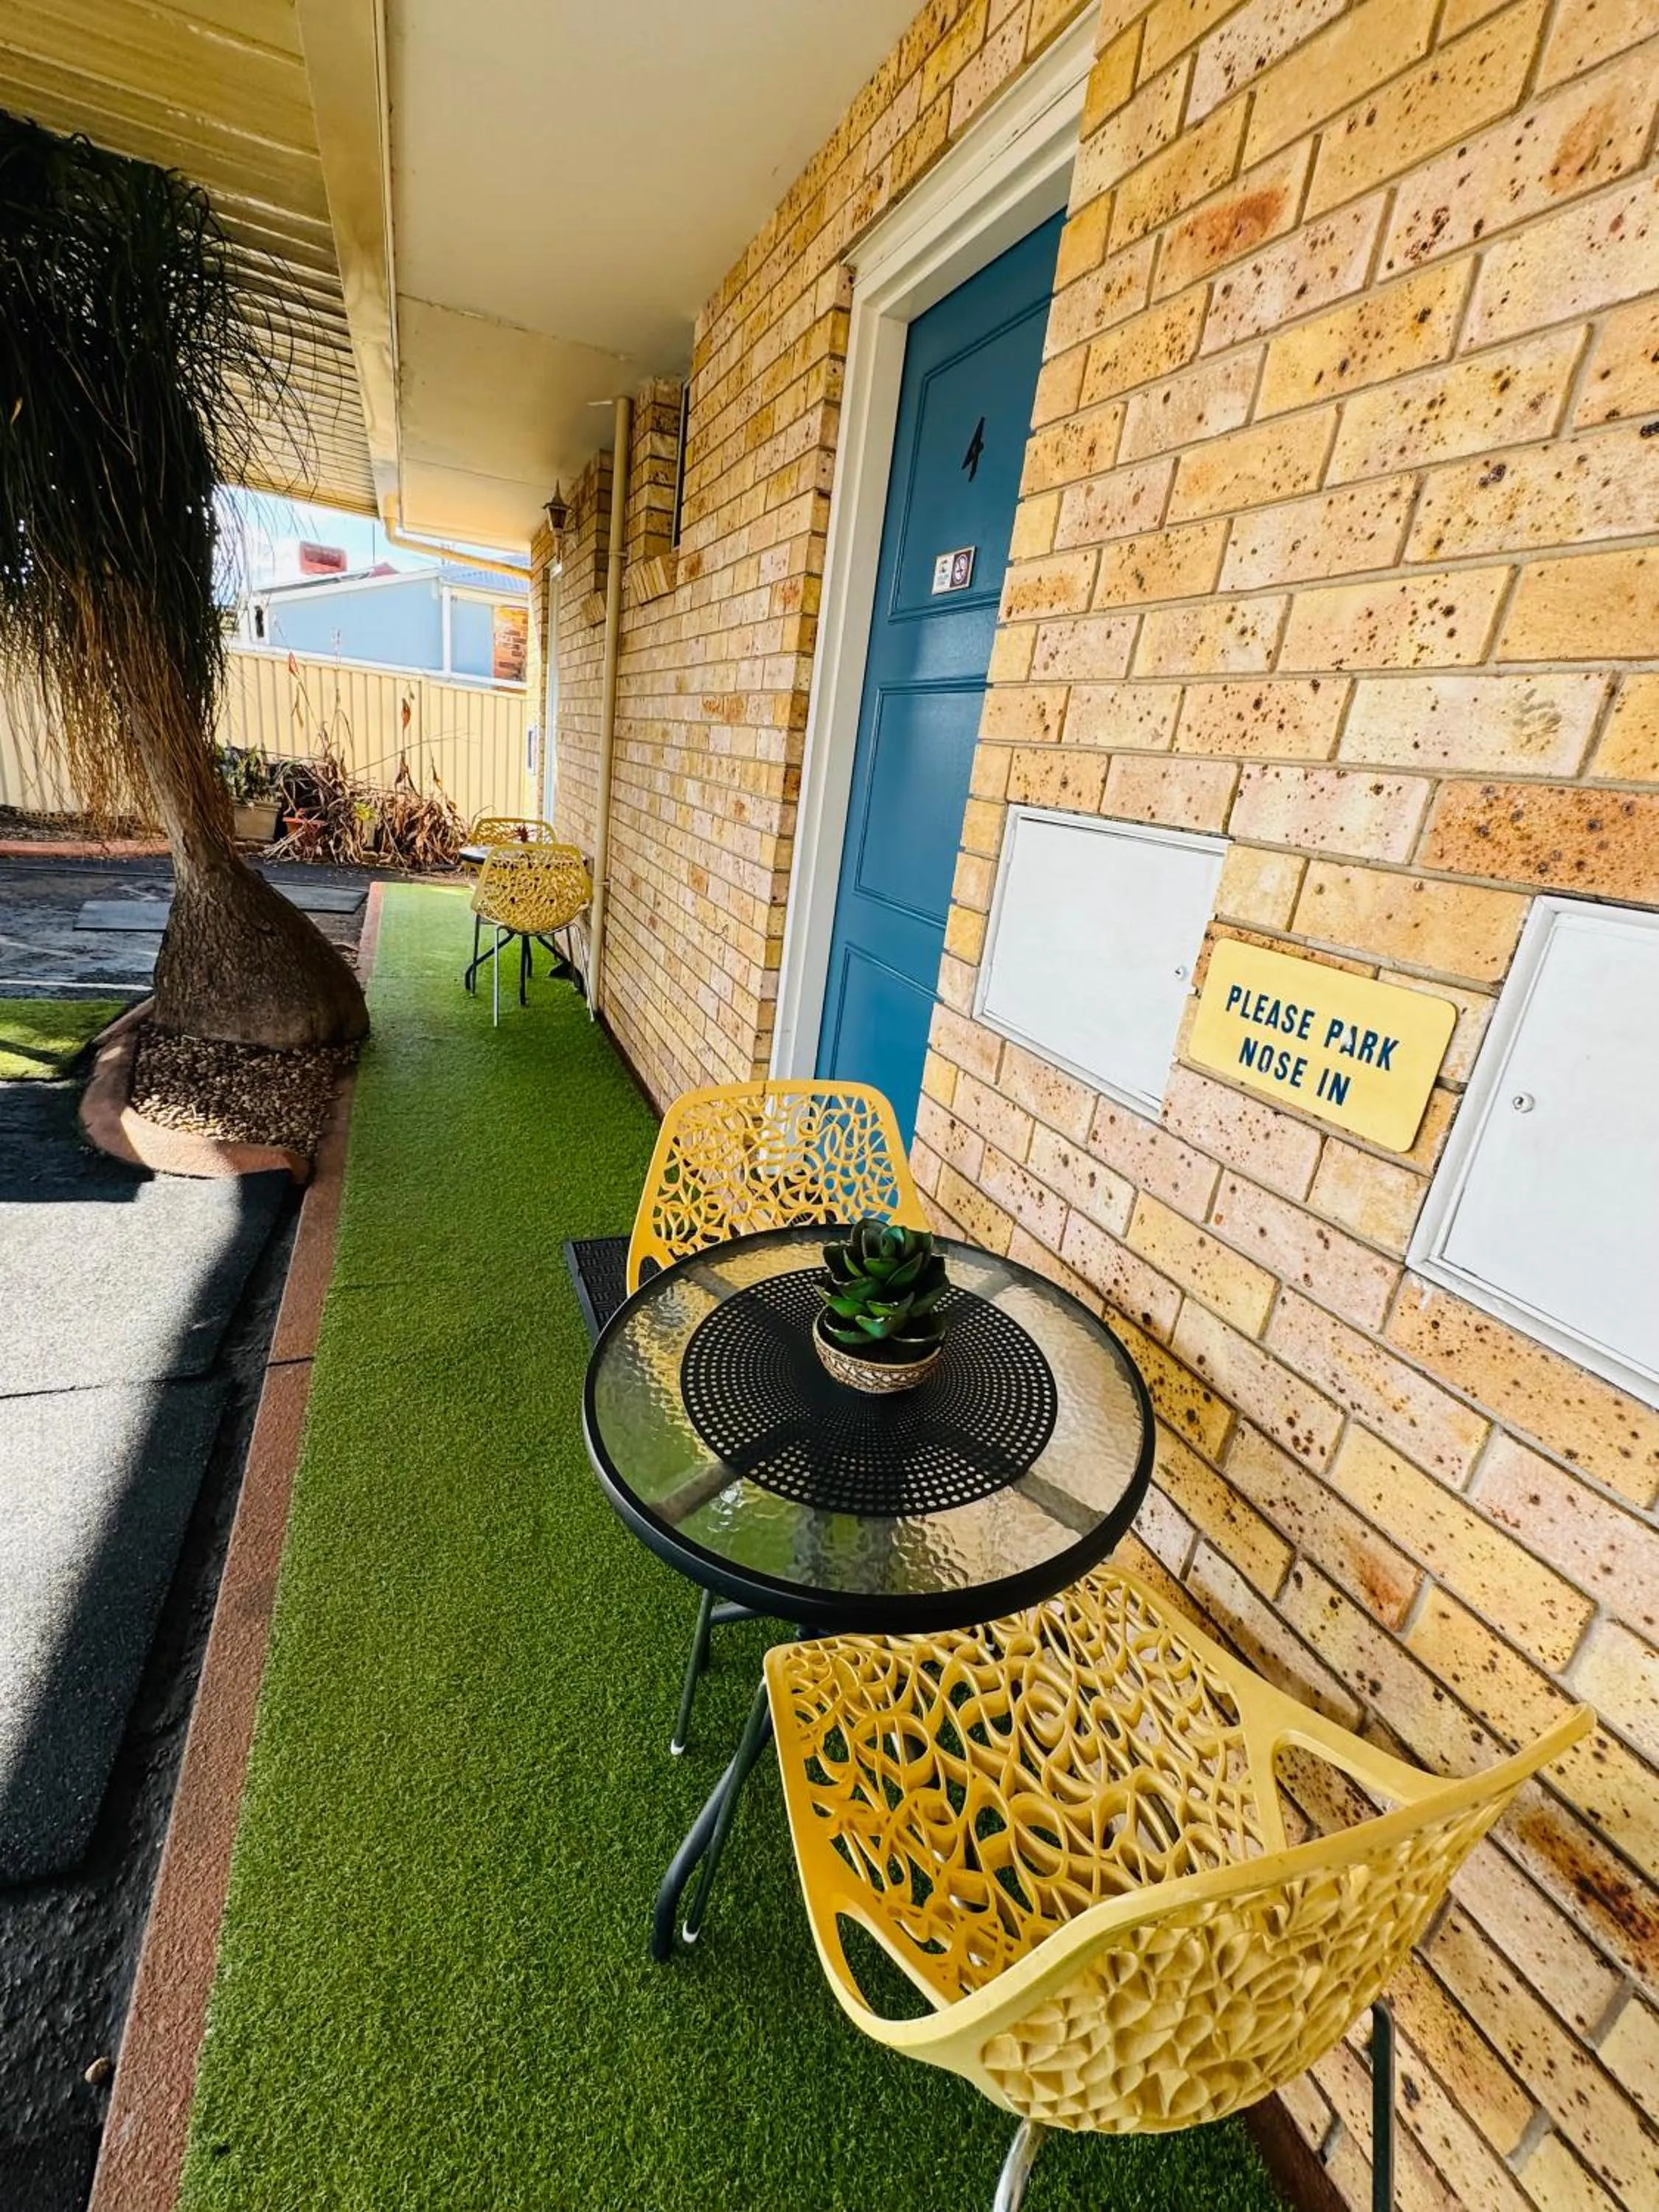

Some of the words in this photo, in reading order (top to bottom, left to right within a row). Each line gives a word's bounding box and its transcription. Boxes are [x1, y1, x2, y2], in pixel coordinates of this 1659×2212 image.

[961, 417, 986, 483] 4
[1225, 984, 1315, 1040] PLEASE
[1324, 1018, 1399, 1071] PARK
[1238, 1037, 1309, 1088] NOSE
[1316, 1068, 1352, 1106] IN
